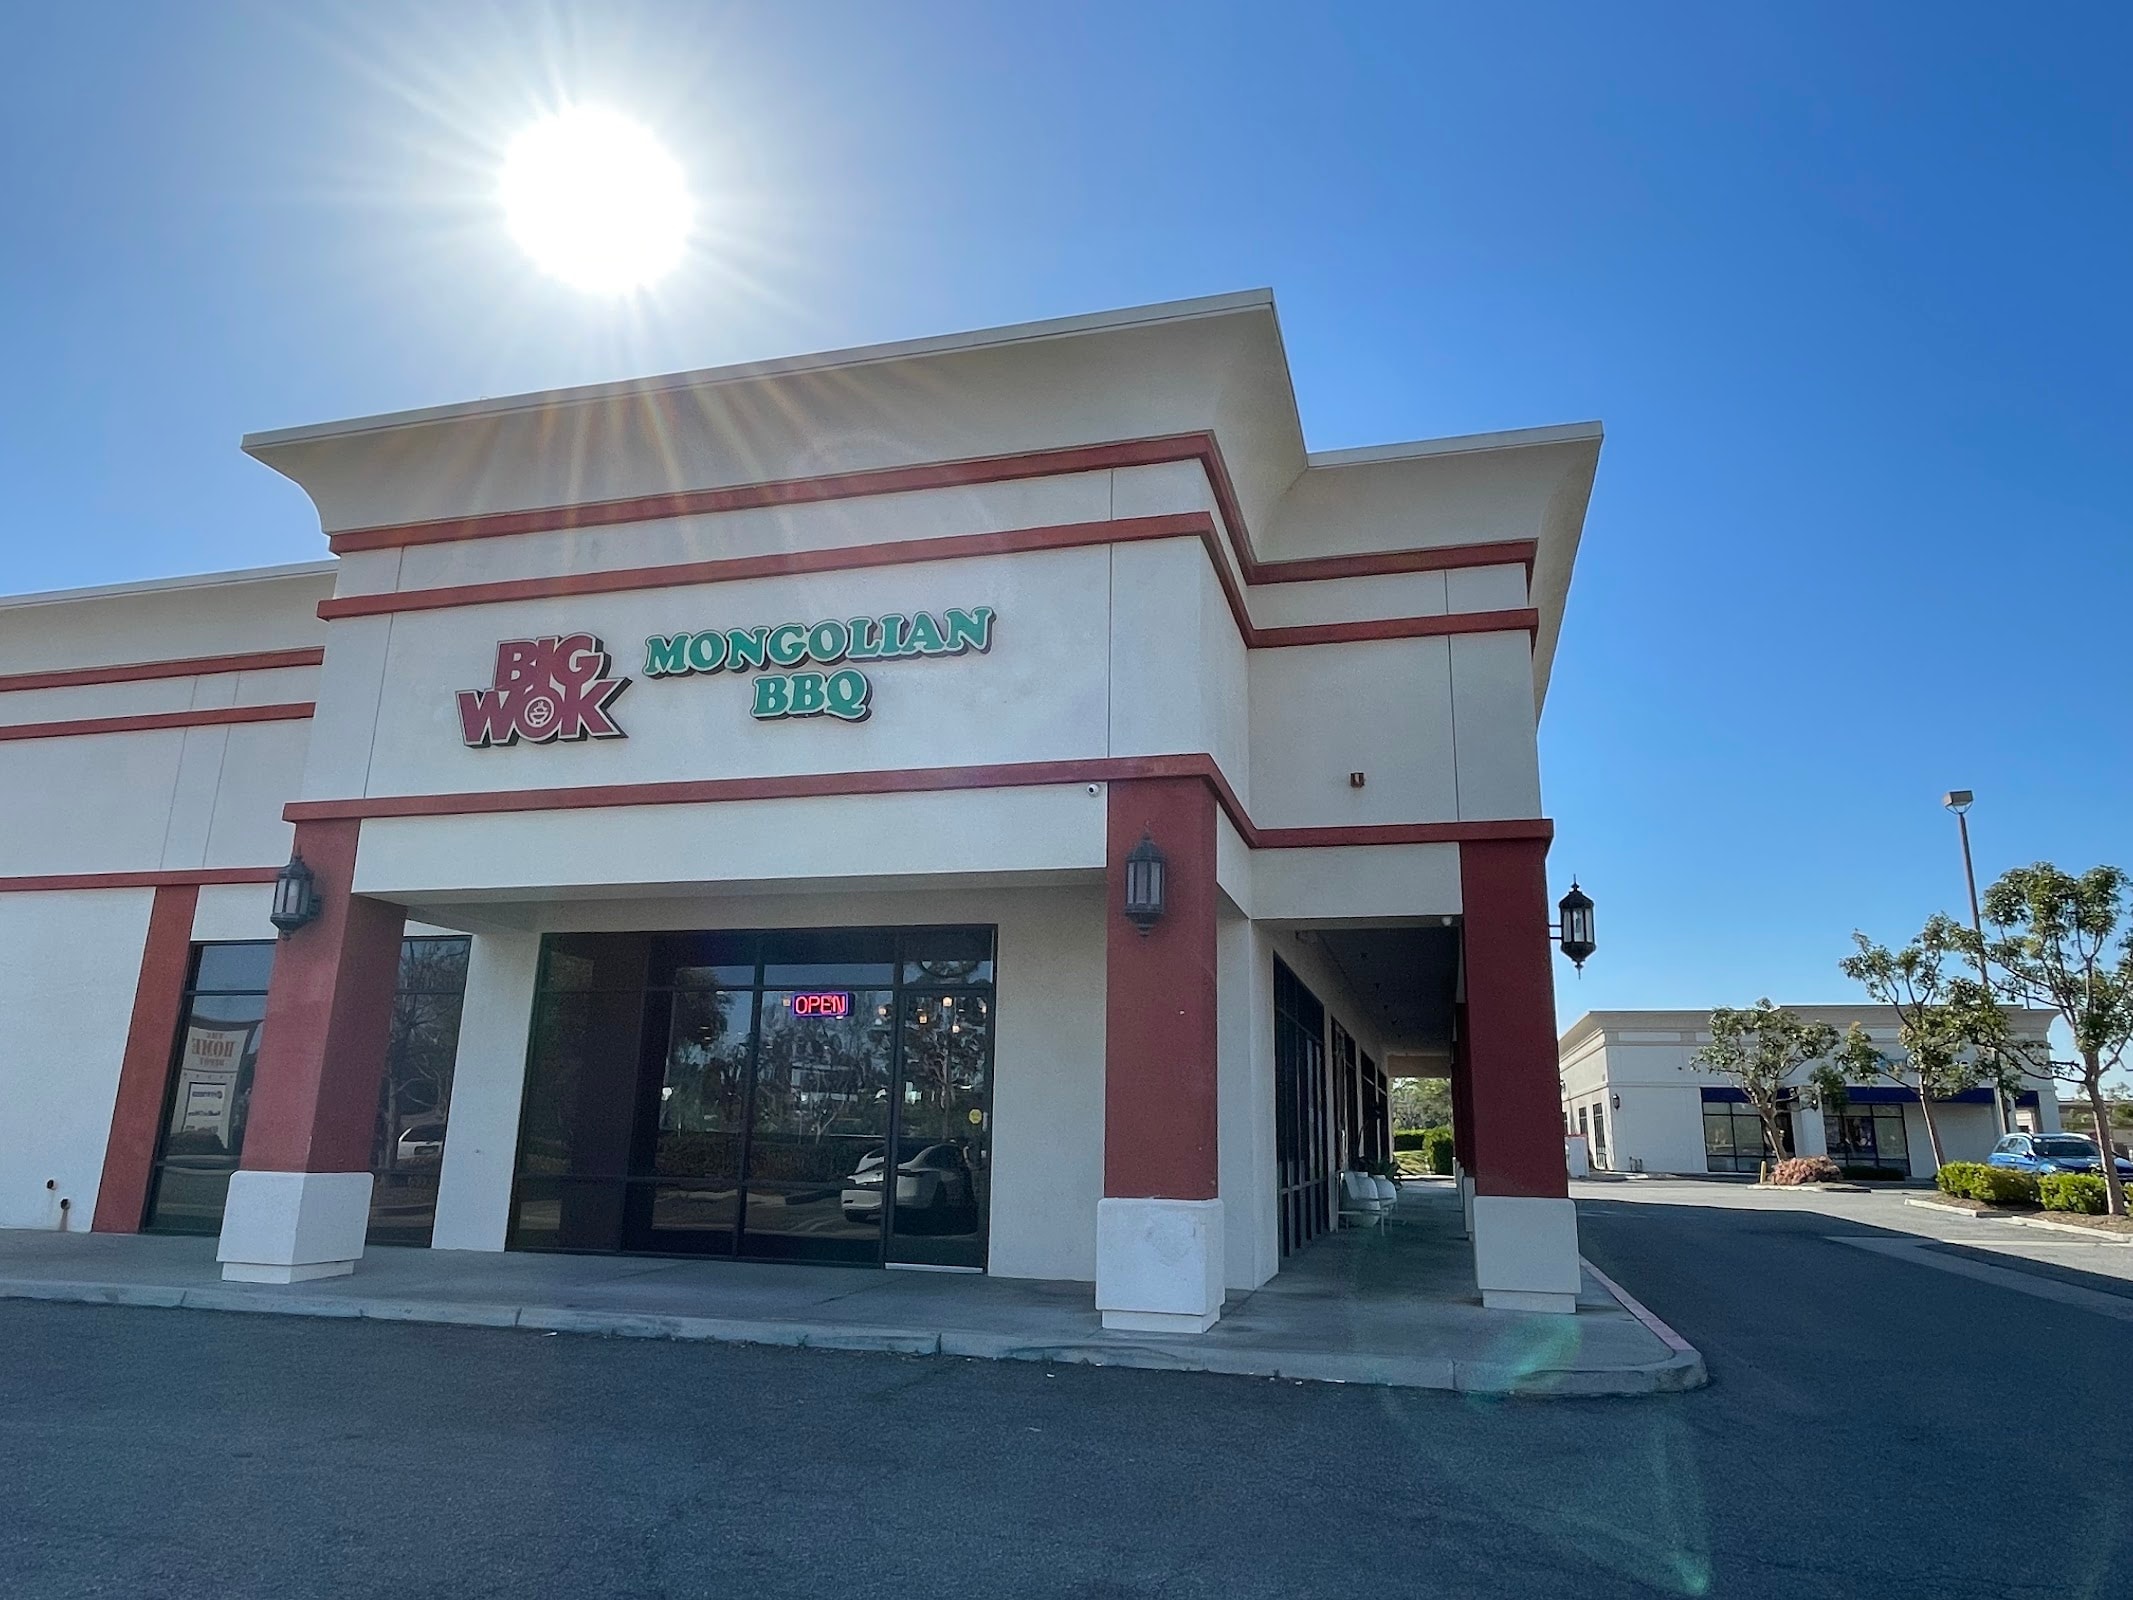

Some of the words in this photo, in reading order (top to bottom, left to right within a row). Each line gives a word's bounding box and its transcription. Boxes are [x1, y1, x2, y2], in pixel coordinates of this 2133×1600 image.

[494, 632, 608, 692] BIG
[643, 607, 994, 678] MONGOLIAN
[455, 677, 629, 746] WOK
[750, 668, 870, 721] BBQ
[795, 994, 846, 1015] OPEN
